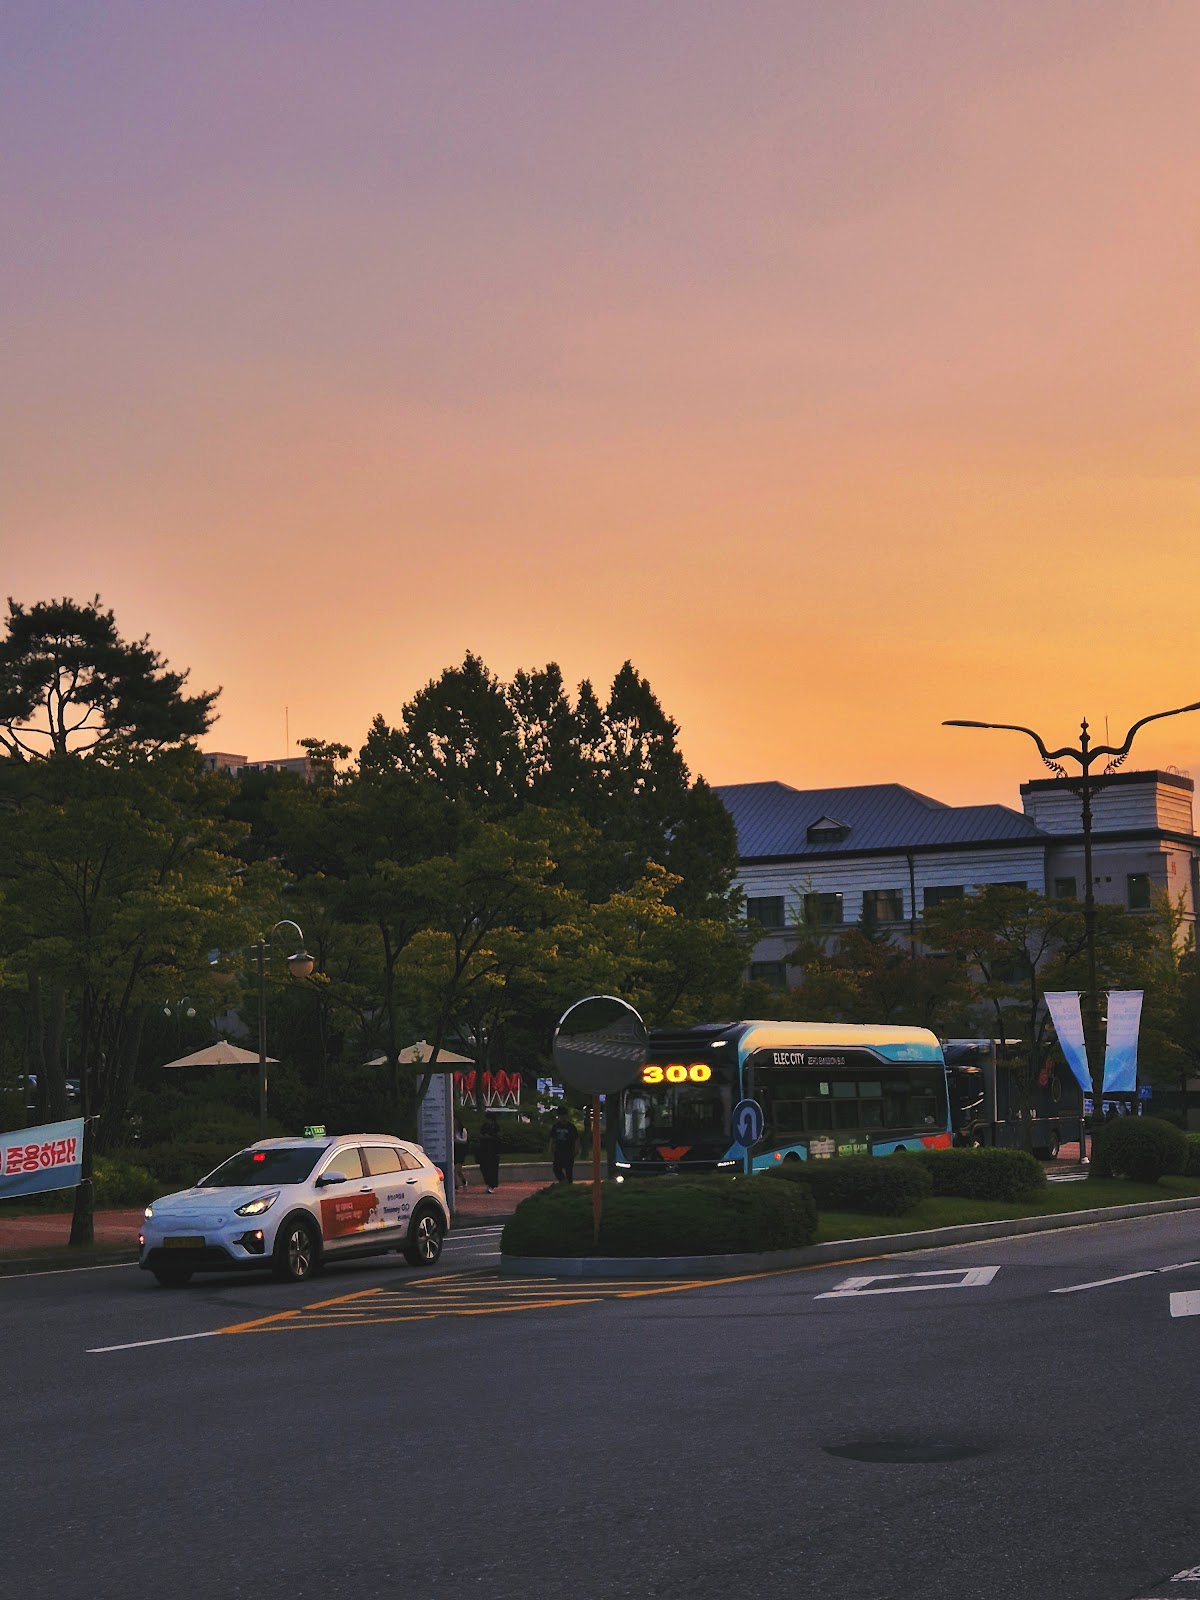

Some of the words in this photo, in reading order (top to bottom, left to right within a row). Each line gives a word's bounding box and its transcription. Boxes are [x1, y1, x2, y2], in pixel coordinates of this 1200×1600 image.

[773, 1052, 790, 1065] ELEC
[790, 1052, 804, 1065] CITY
[642, 1064, 712, 1083] 300
[5, 1138, 77, 1174] 준용하라!
